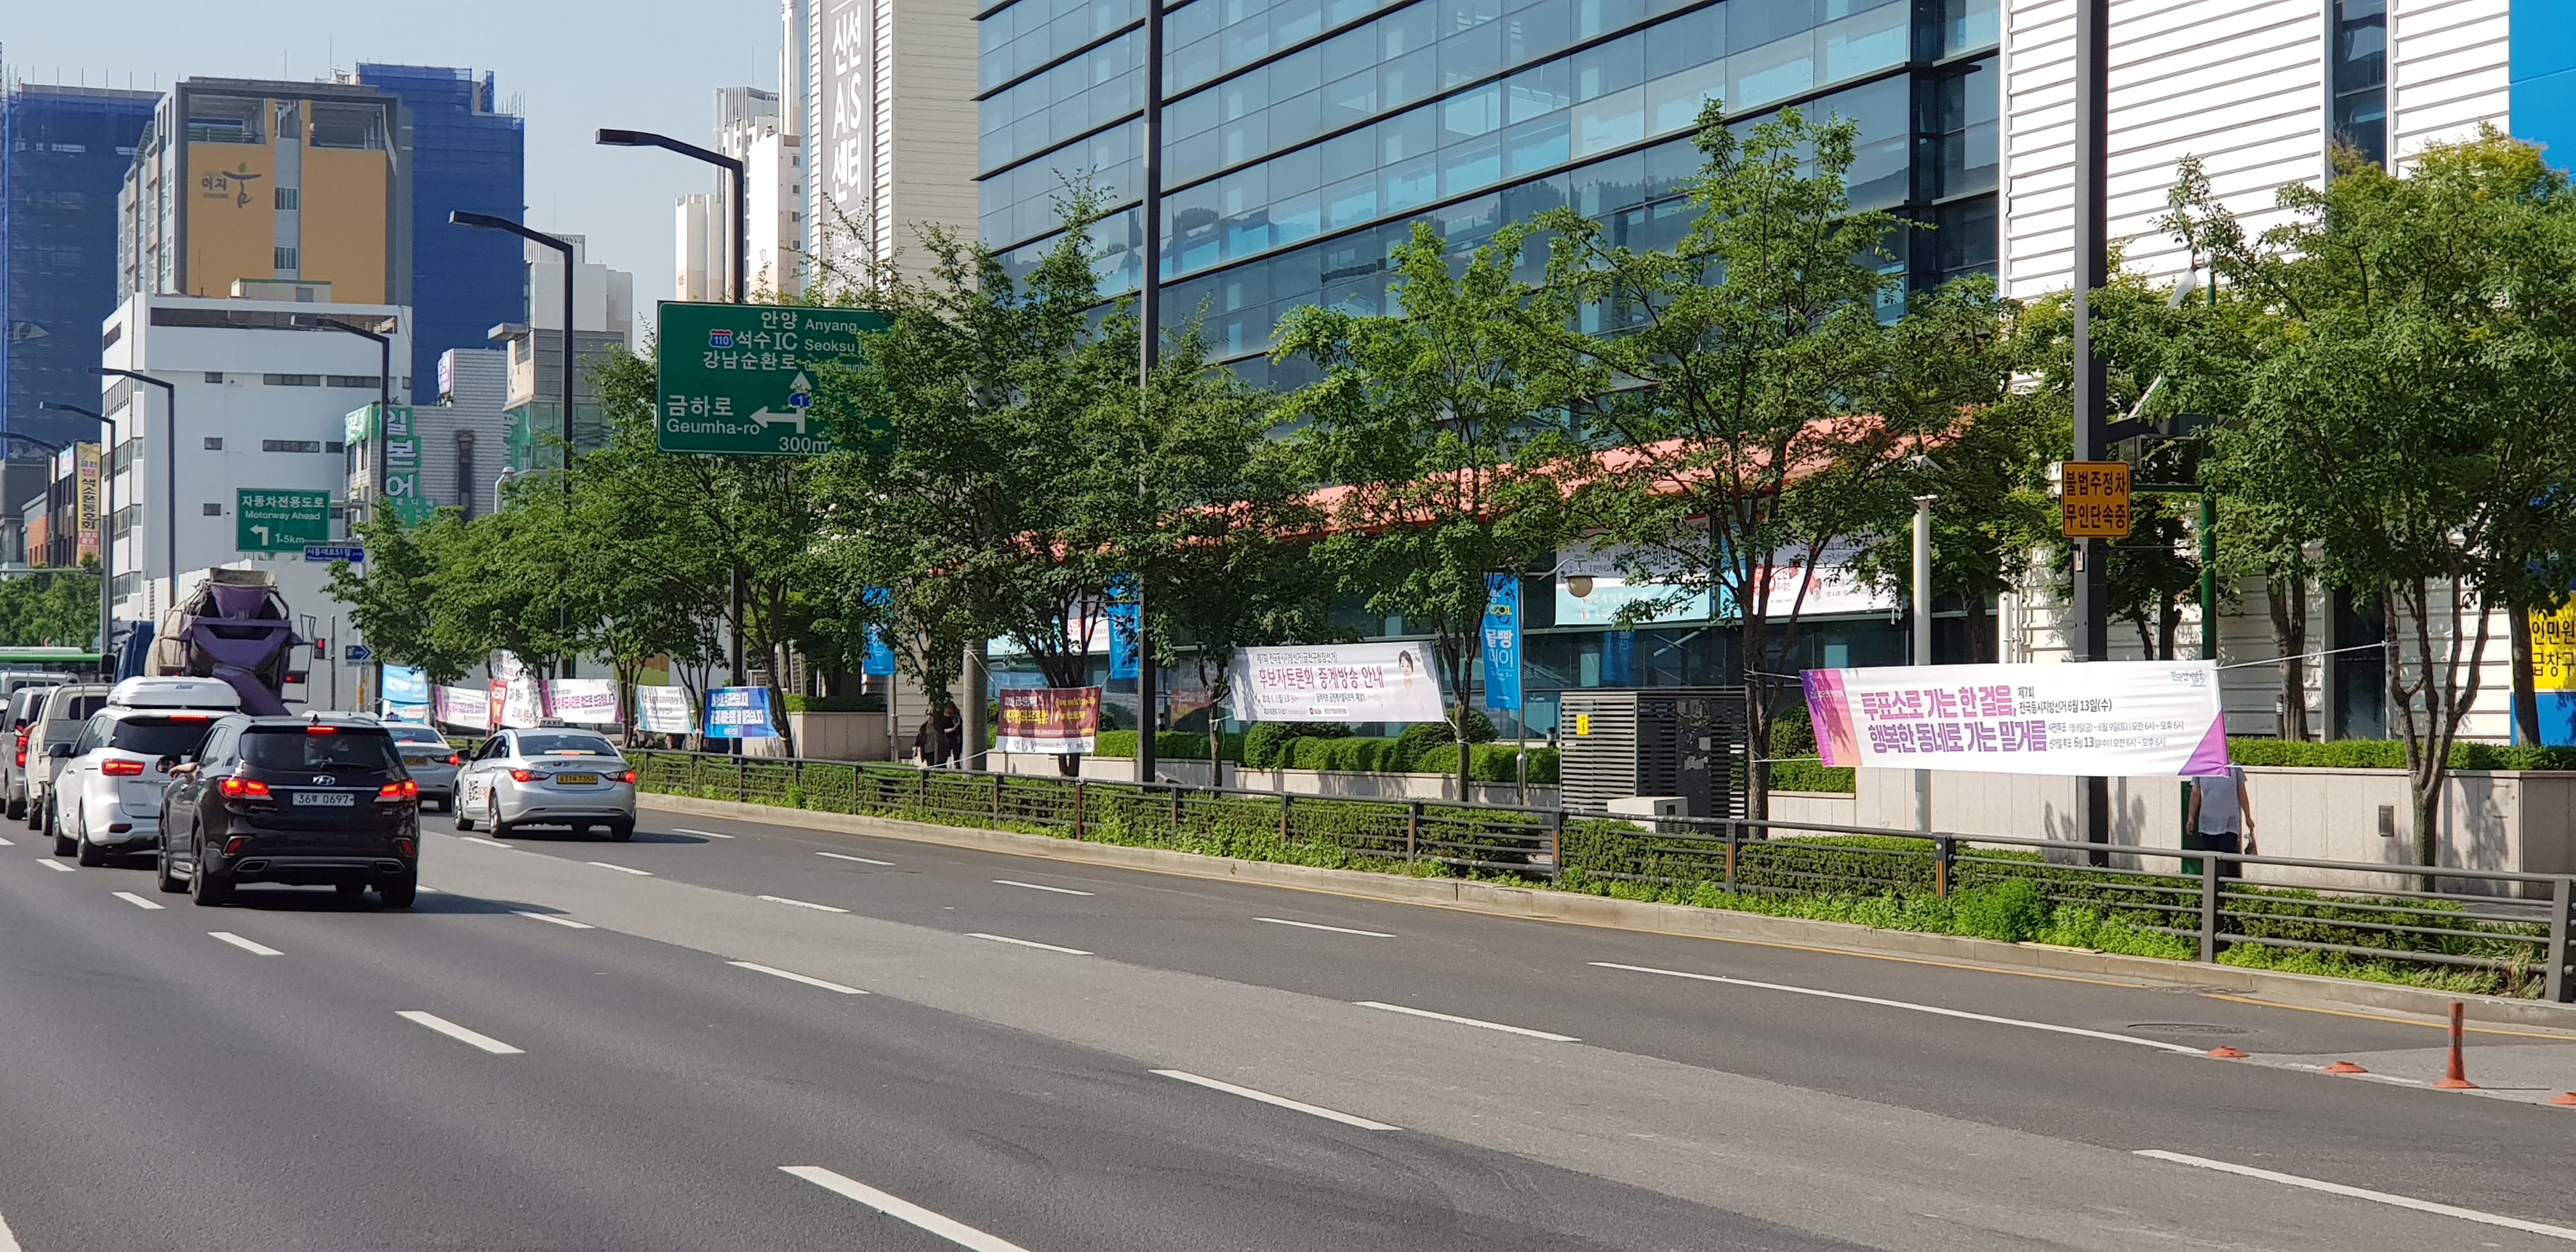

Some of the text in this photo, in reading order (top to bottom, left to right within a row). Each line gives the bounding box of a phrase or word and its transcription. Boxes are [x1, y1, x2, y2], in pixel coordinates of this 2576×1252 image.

[832, 5, 862, 77] 신선
[832, 72, 862, 140] A/S
[832, 132, 862, 206] 센터
[760, 310, 858, 333] 안양 Anyang
[713, 335, 730, 346] 110
[804, 339, 855, 352] Seoksu
[703, 351, 799, 371] 강남순환로
[666, 394, 735, 418] 금하로
[666, 418, 761, 436] Geumha-ro
[778, 436, 829, 453] 300m
[2065, 470, 2126, 496] 불법주정차
[241, 495, 325, 508] 자동차전용도로
[245, 510, 321, 521] Motorway Ahead
[2066, 503, 2126, 529] 무인단속중
[1259, 666, 1384, 689] 후보자토론회 중계방송 안내
[1860, 685, 2016, 721] 투표소로 가는 한 걸음,
[2018, 686, 2035, 699] 제7회
[2019, 698, 2112, 714] 전국동시지방선거 6월 13일(수)
[1867, 723, 1916, 753] 행복한
[1915, 722, 1965, 752] 동네로
[1964, 721, 1998, 752] 가는
[323, 794, 349, 804] 0697
